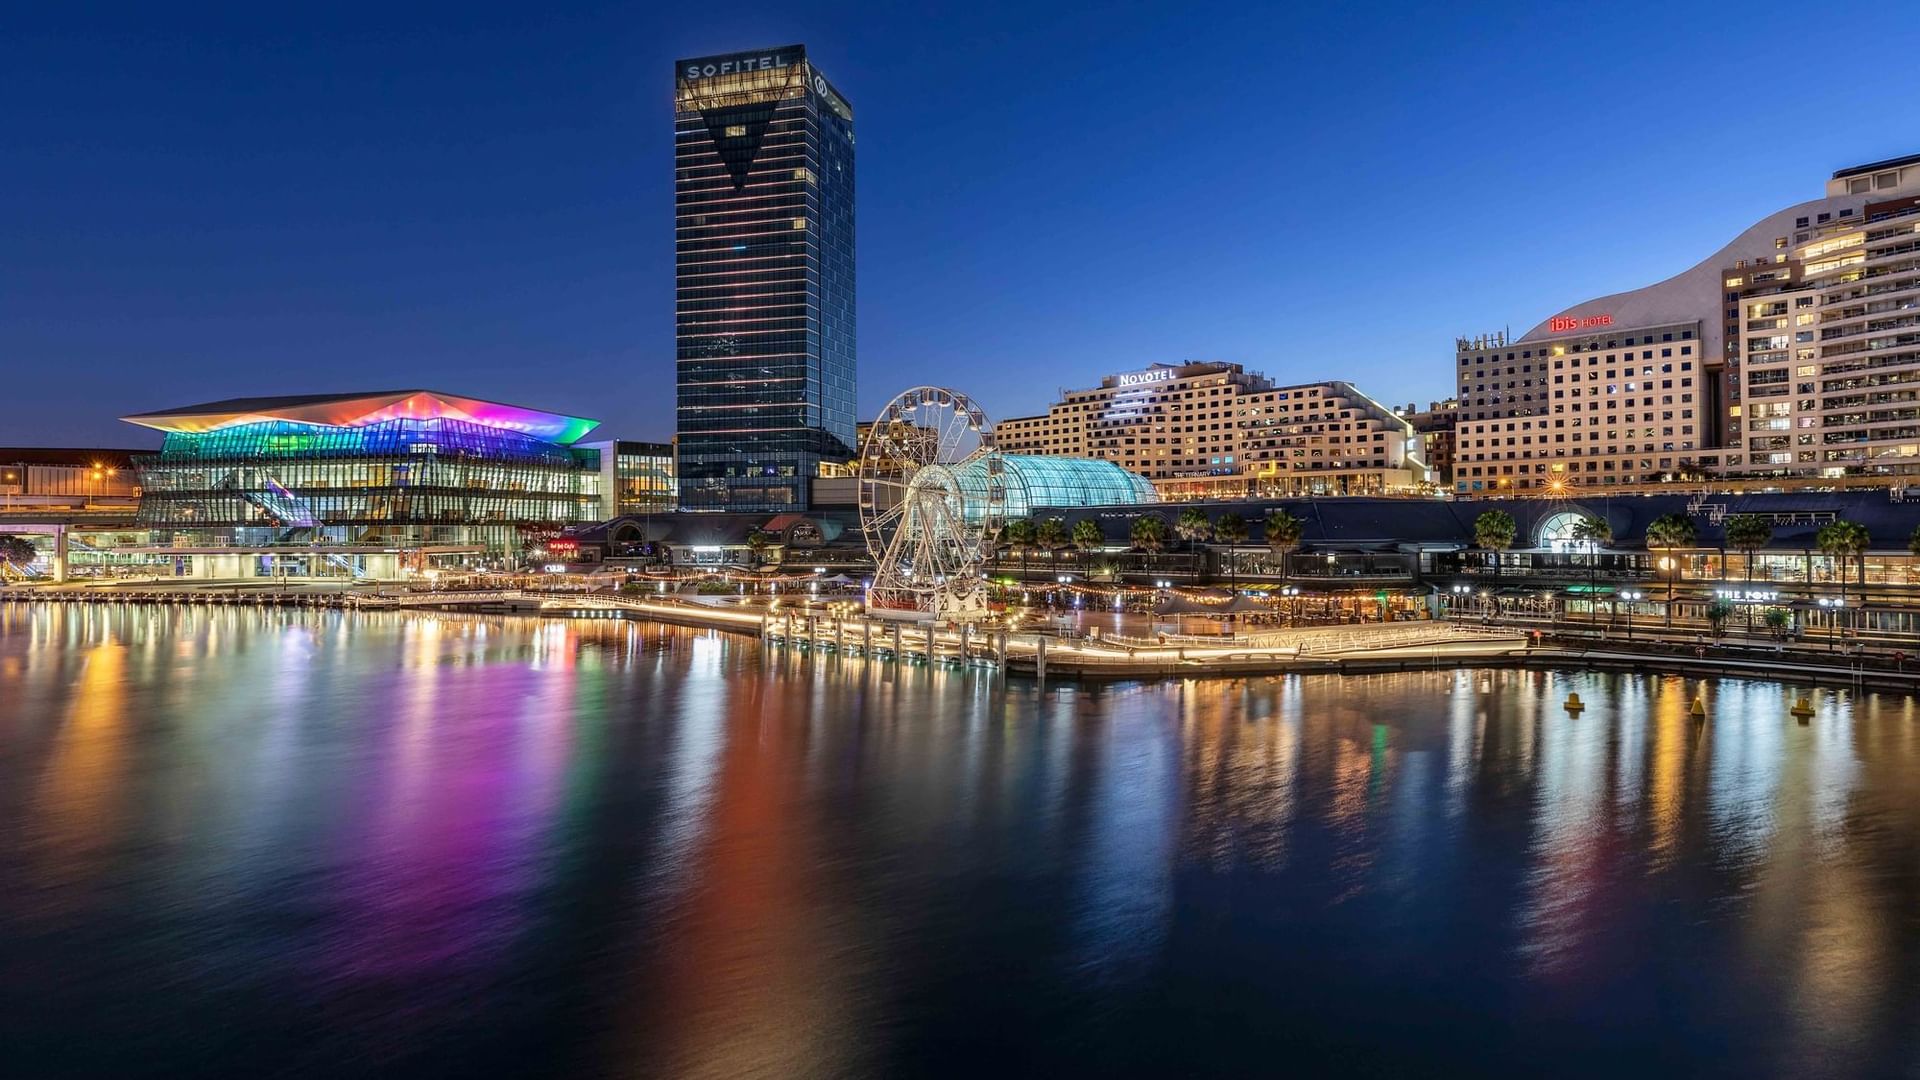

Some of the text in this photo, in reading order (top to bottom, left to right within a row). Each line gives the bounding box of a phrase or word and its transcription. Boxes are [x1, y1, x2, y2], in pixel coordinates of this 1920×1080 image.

[687, 55, 788, 79] SOFITEL
[1550, 315, 1615, 332] ibis HOTEL
[1120, 369, 1176, 386] NOVOTEL
[1716, 590, 1741, 599] THE
